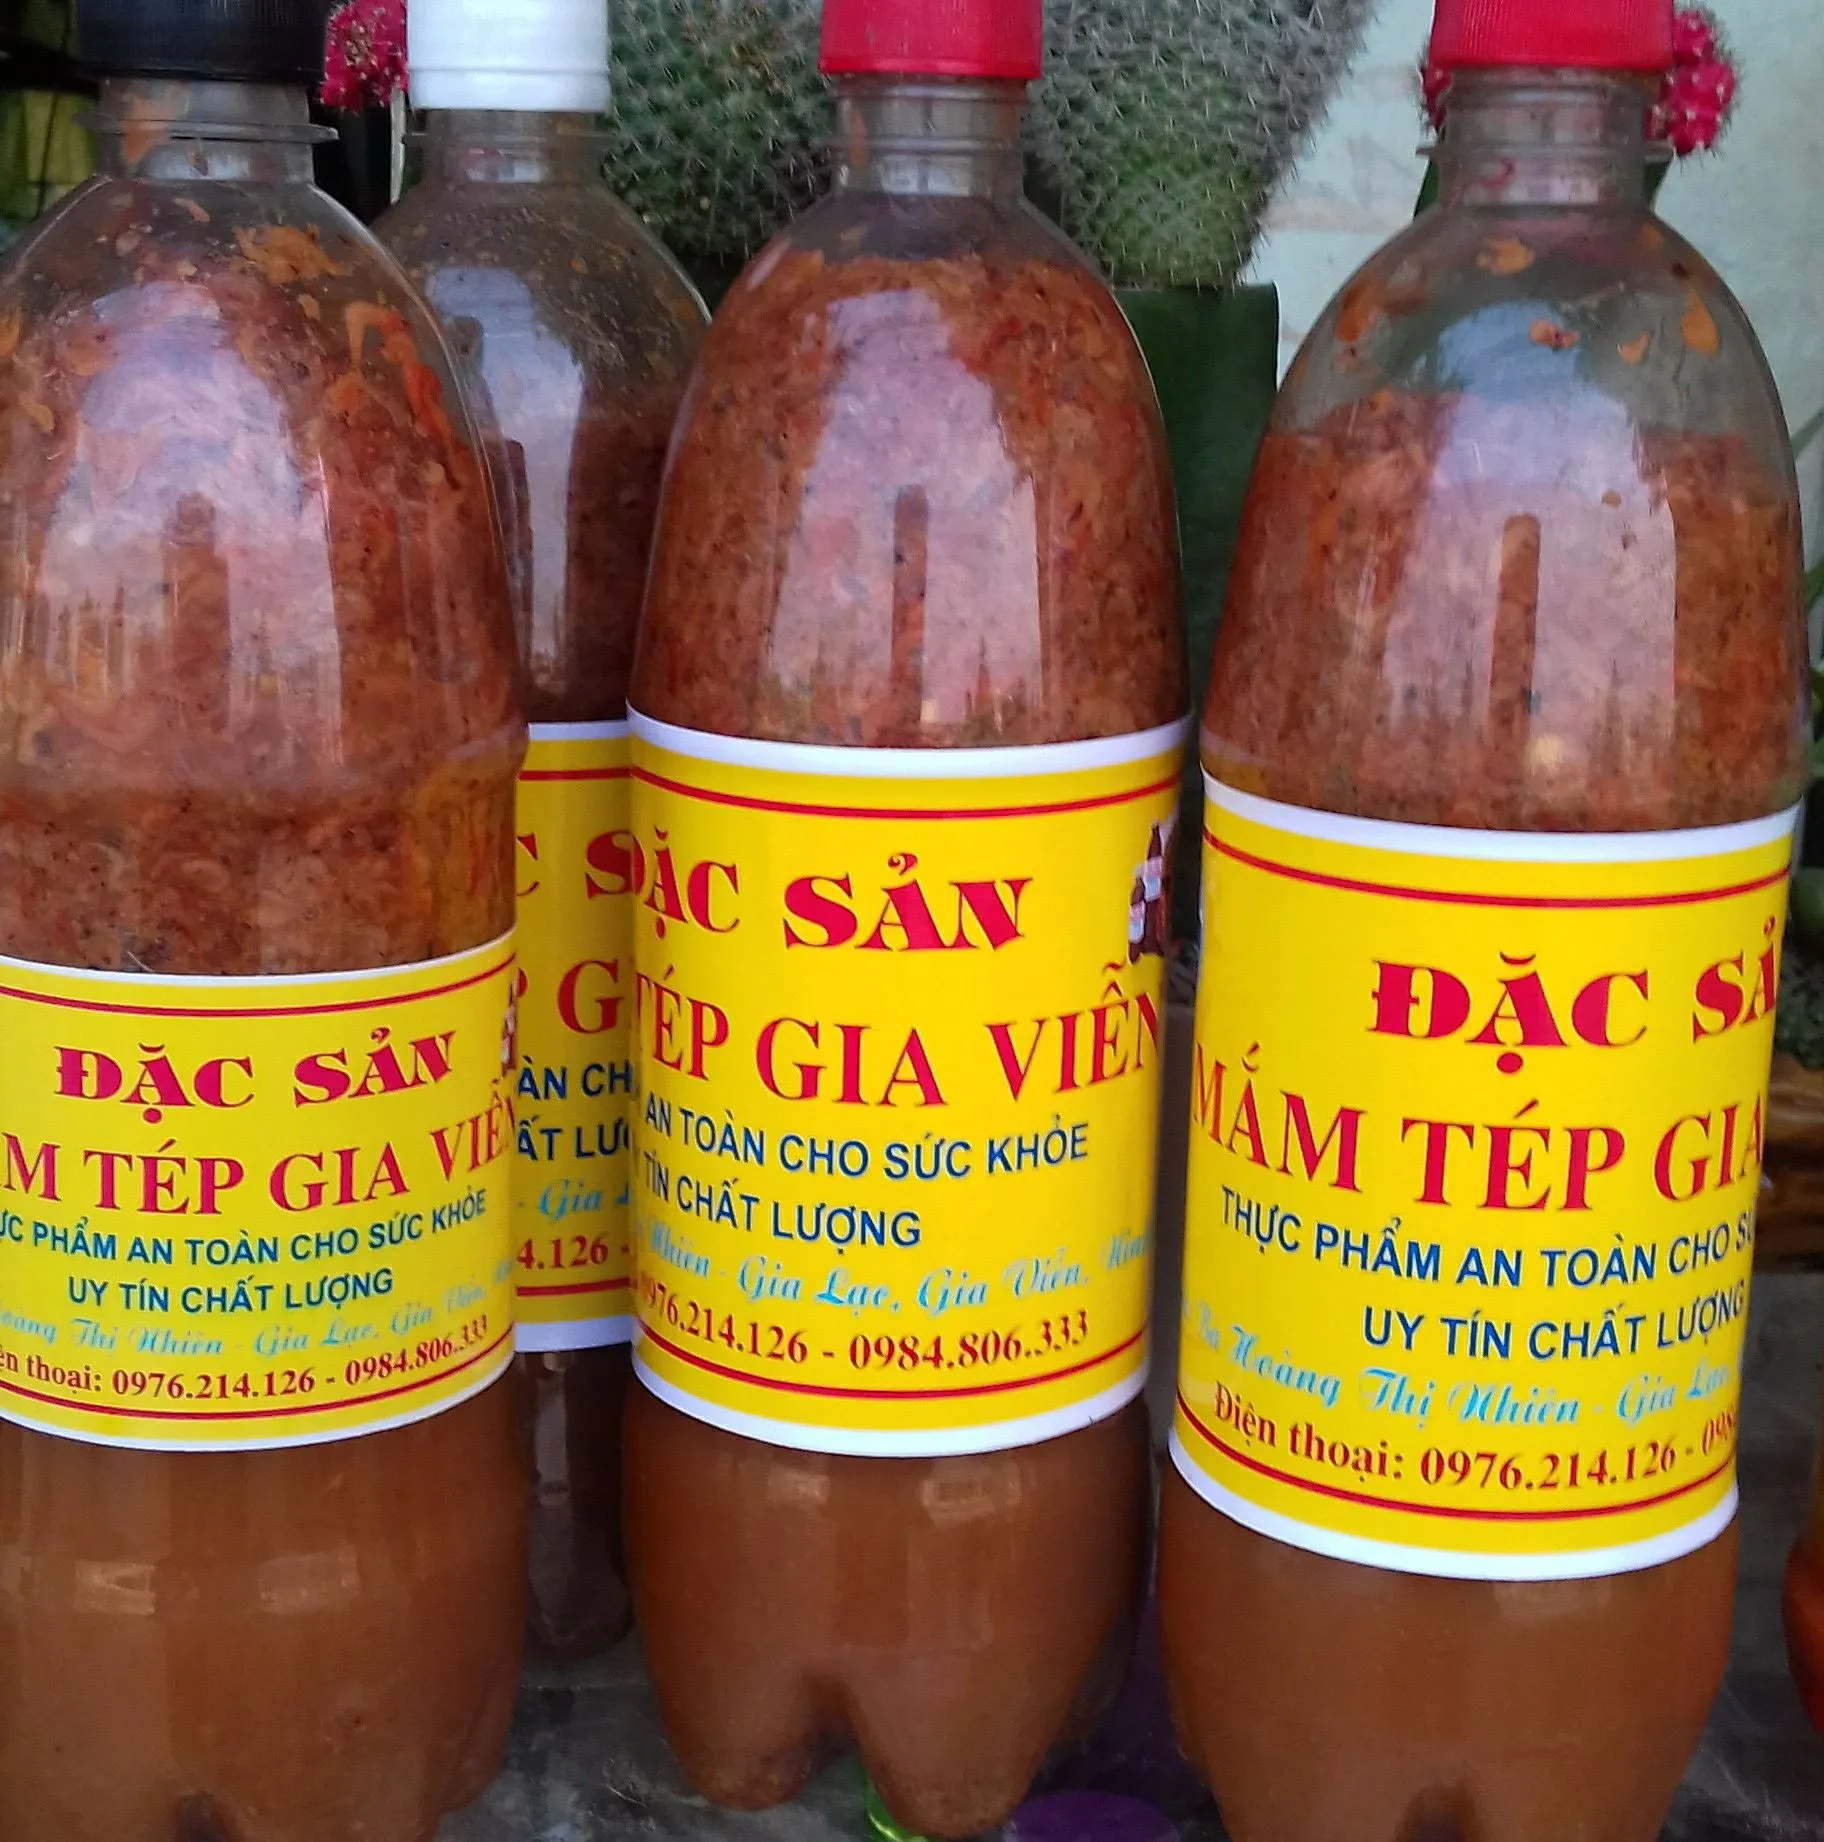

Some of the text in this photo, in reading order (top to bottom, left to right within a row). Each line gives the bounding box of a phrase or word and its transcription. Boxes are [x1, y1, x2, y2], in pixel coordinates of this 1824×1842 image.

[783, 852, 1033, 952] SẢN
[1366, 914, 1776, 1074] ĐẶC SẢ
[54, 1027, 455, 1124] ĐẶC SẢN
[581, 1060, 632, 1097] CH
[755, 1017, 949, 1107] GIA
[646, 1091, 672, 1138] AN
[680, 1109, 766, 1166] TOÀN
[780, 1134, 870, 1177] CHO
[884, 1132, 971, 1180] SỨC
[987, 1113, 1089, 1175] KHỎE
[1192, 1040, 1760, 1212] MẮM TÉP GIA
[83, 1138, 245, 1214] TÉP
[269, 1142, 410, 1211] GIA
[538, 1178, 603, 1222] Gia
[676, 1177, 761, 1232] CHẤT
[772, 1200, 921, 1256] LƯỢNG
[32, 1216, 116, 1260] PHẨM
[127, 1237, 173, 1264] AN
[185, 1229, 278, 1265] TOÀN
[290, 1228, 358, 1260] CHO
[368, 1211, 423, 1250] SỨC
[432, 1185, 486, 1233] KHỎE
[1222, 1185, 1301, 1254] THỰC
[1314, 1217, 1442, 1283] PHẨM
[1455, 1247, 1522, 1287] AN
[1540, 1233, 1656, 1287] TOÀN
[1668, 1223, 1730, 1276] CHO
[0, 1305, 57, 1345] oàng
[69, 1267, 393, 1313] UY TÍN CHẤT LƯỢNG
[738, 1255, 802, 1303] Gia
[915, 1267, 988, 1319] Gia
[1364, 1280, 1744, 1361] UY TÍN CHẤT LƯỢNG
[26, 1354, 101, 1395] thoại:
[112, 1367, 316, 1399] 0976.214.126
[344, 1315, 488, 1386] 0984.806.333
[849, 1307, 1089, 1370] 0984.806.333
[1230, 1324, 1341, 1409] Hoàng
[1360, 1367, 1436, 1431] Thị
[1447, 1382, 1580, 1425] Nhiên
[1617, 1372, 1676, 1428] Gia
[1214, 1381, 1277, 1448] Điện
[1288, 1422, 1404, 1484] thoại:
[1420, 1435, 1677, 1493] 0976.214.126
